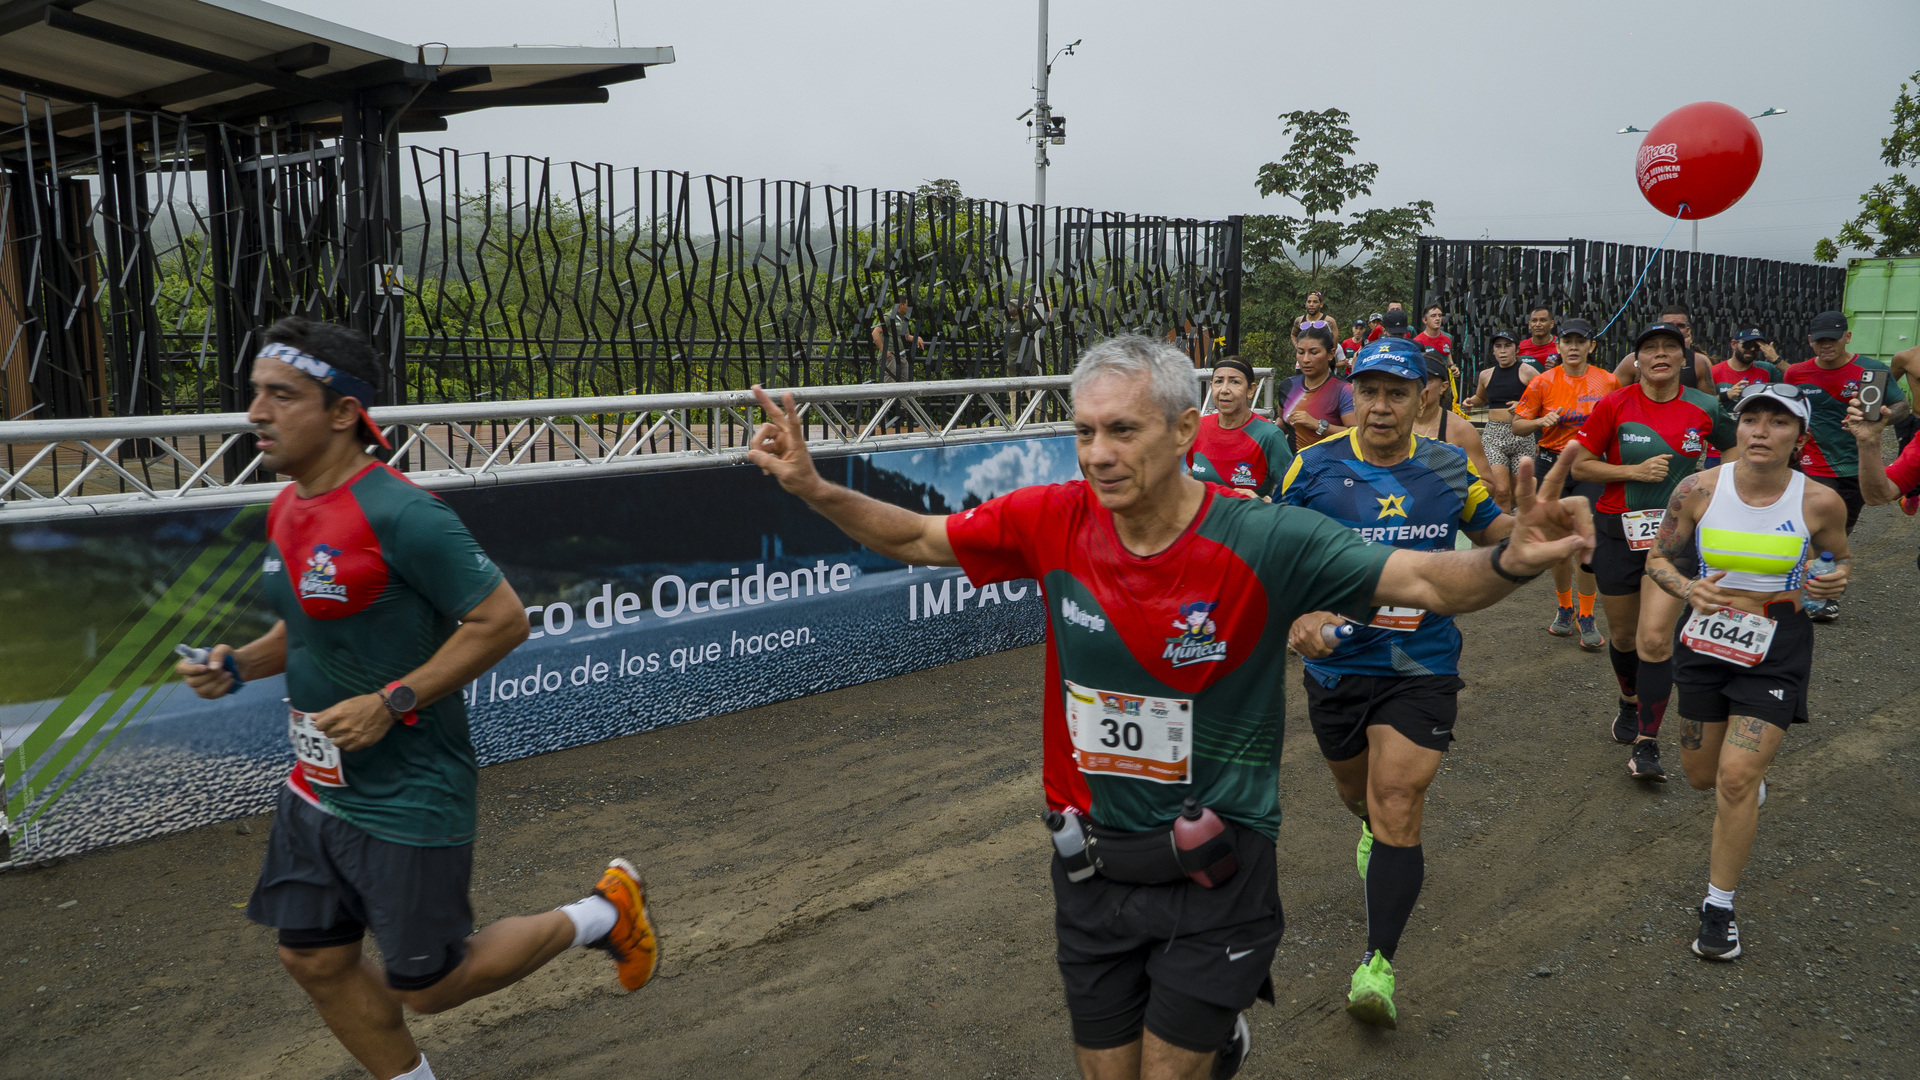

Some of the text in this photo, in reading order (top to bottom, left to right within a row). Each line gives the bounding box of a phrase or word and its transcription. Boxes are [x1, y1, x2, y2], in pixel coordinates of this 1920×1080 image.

[1650, 165, 1681, 177] MIN/KM
[1658, 172, 1679, 182] MINS
[1362, 353, 1406, 364] ACERTEMOS
[585, 584, 641, 629] de
[651, 559, 851, 618] Occidente
[1698, 618, 1755, 649] 1644
[489, 664, 562, 703] lado
[570, 654, 609, 686] de
[619, 648, 660, 678] los
[669, 642, 721, 674] que
[730, 626, 816, 658] hacen.
[1162, 640, 1227, 664] Muñeca
[1100, 718, 1143, 751] 30
